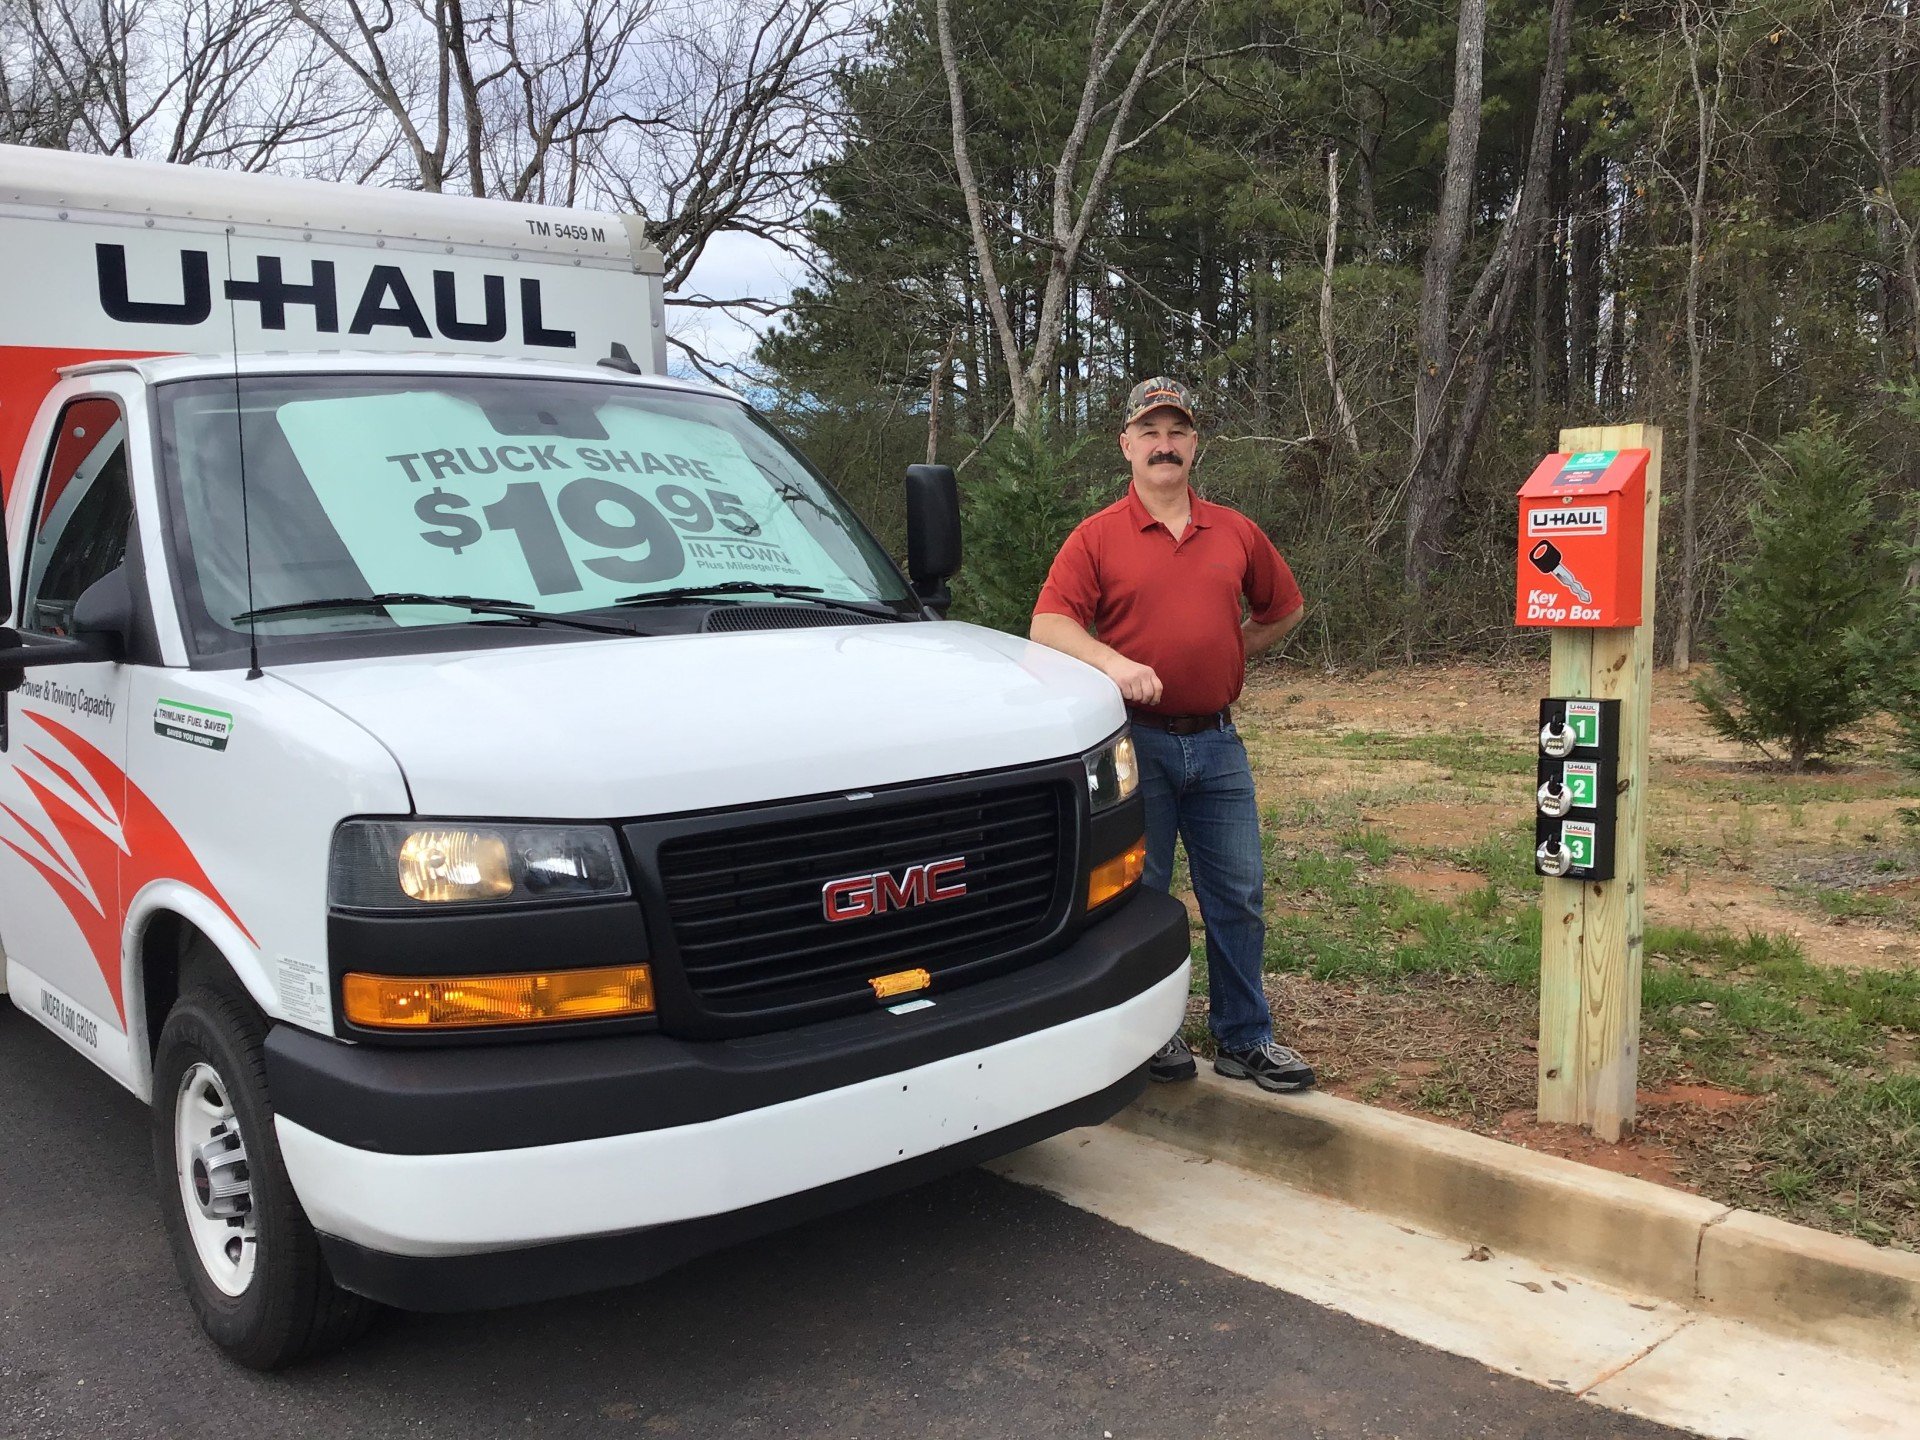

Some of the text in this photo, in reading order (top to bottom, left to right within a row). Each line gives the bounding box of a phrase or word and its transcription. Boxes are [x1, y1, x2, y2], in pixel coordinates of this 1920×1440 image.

[525, 219, 606, 243] TM 5459 M
[95, 242, 577, 349] U-HAUL
[386, 445, 729, 485] TRUCK SHARE
[1533, 511, 1602, 526] U-HAUL
[688, 543, 792, 565] IN-TOWN
[697, 560, 801, 576] Plus Mileage/Fees
[1528, 589, 1558, 607] Key
[1527, 604, 1602, 622] Drop Box
[43, 680, 51, 701] &
[51, 681, 77, 714] Towing
[77, 688, 116, 724] Capacity
[1570, 703, 1596, 711] U-HAUL
[159, 708, 226, 734] TRIMLINE FUEL SAVER
[1576, 719, 1587, 739] 1
[166, 727, 214, 747] SAVES YOU MONEY
[1567, 763, 1593, 771] U-HAUL
[1573, 779, 1587, 799] 2
[1566, 824, 1592, 832] U-HAUL
[1571, 839, 1585, 859] 3
[822, 856, 967, 922] GMC
[40, 988, 61, 1022] UNDER
[76, 1013, 98, 1048] GROSS
